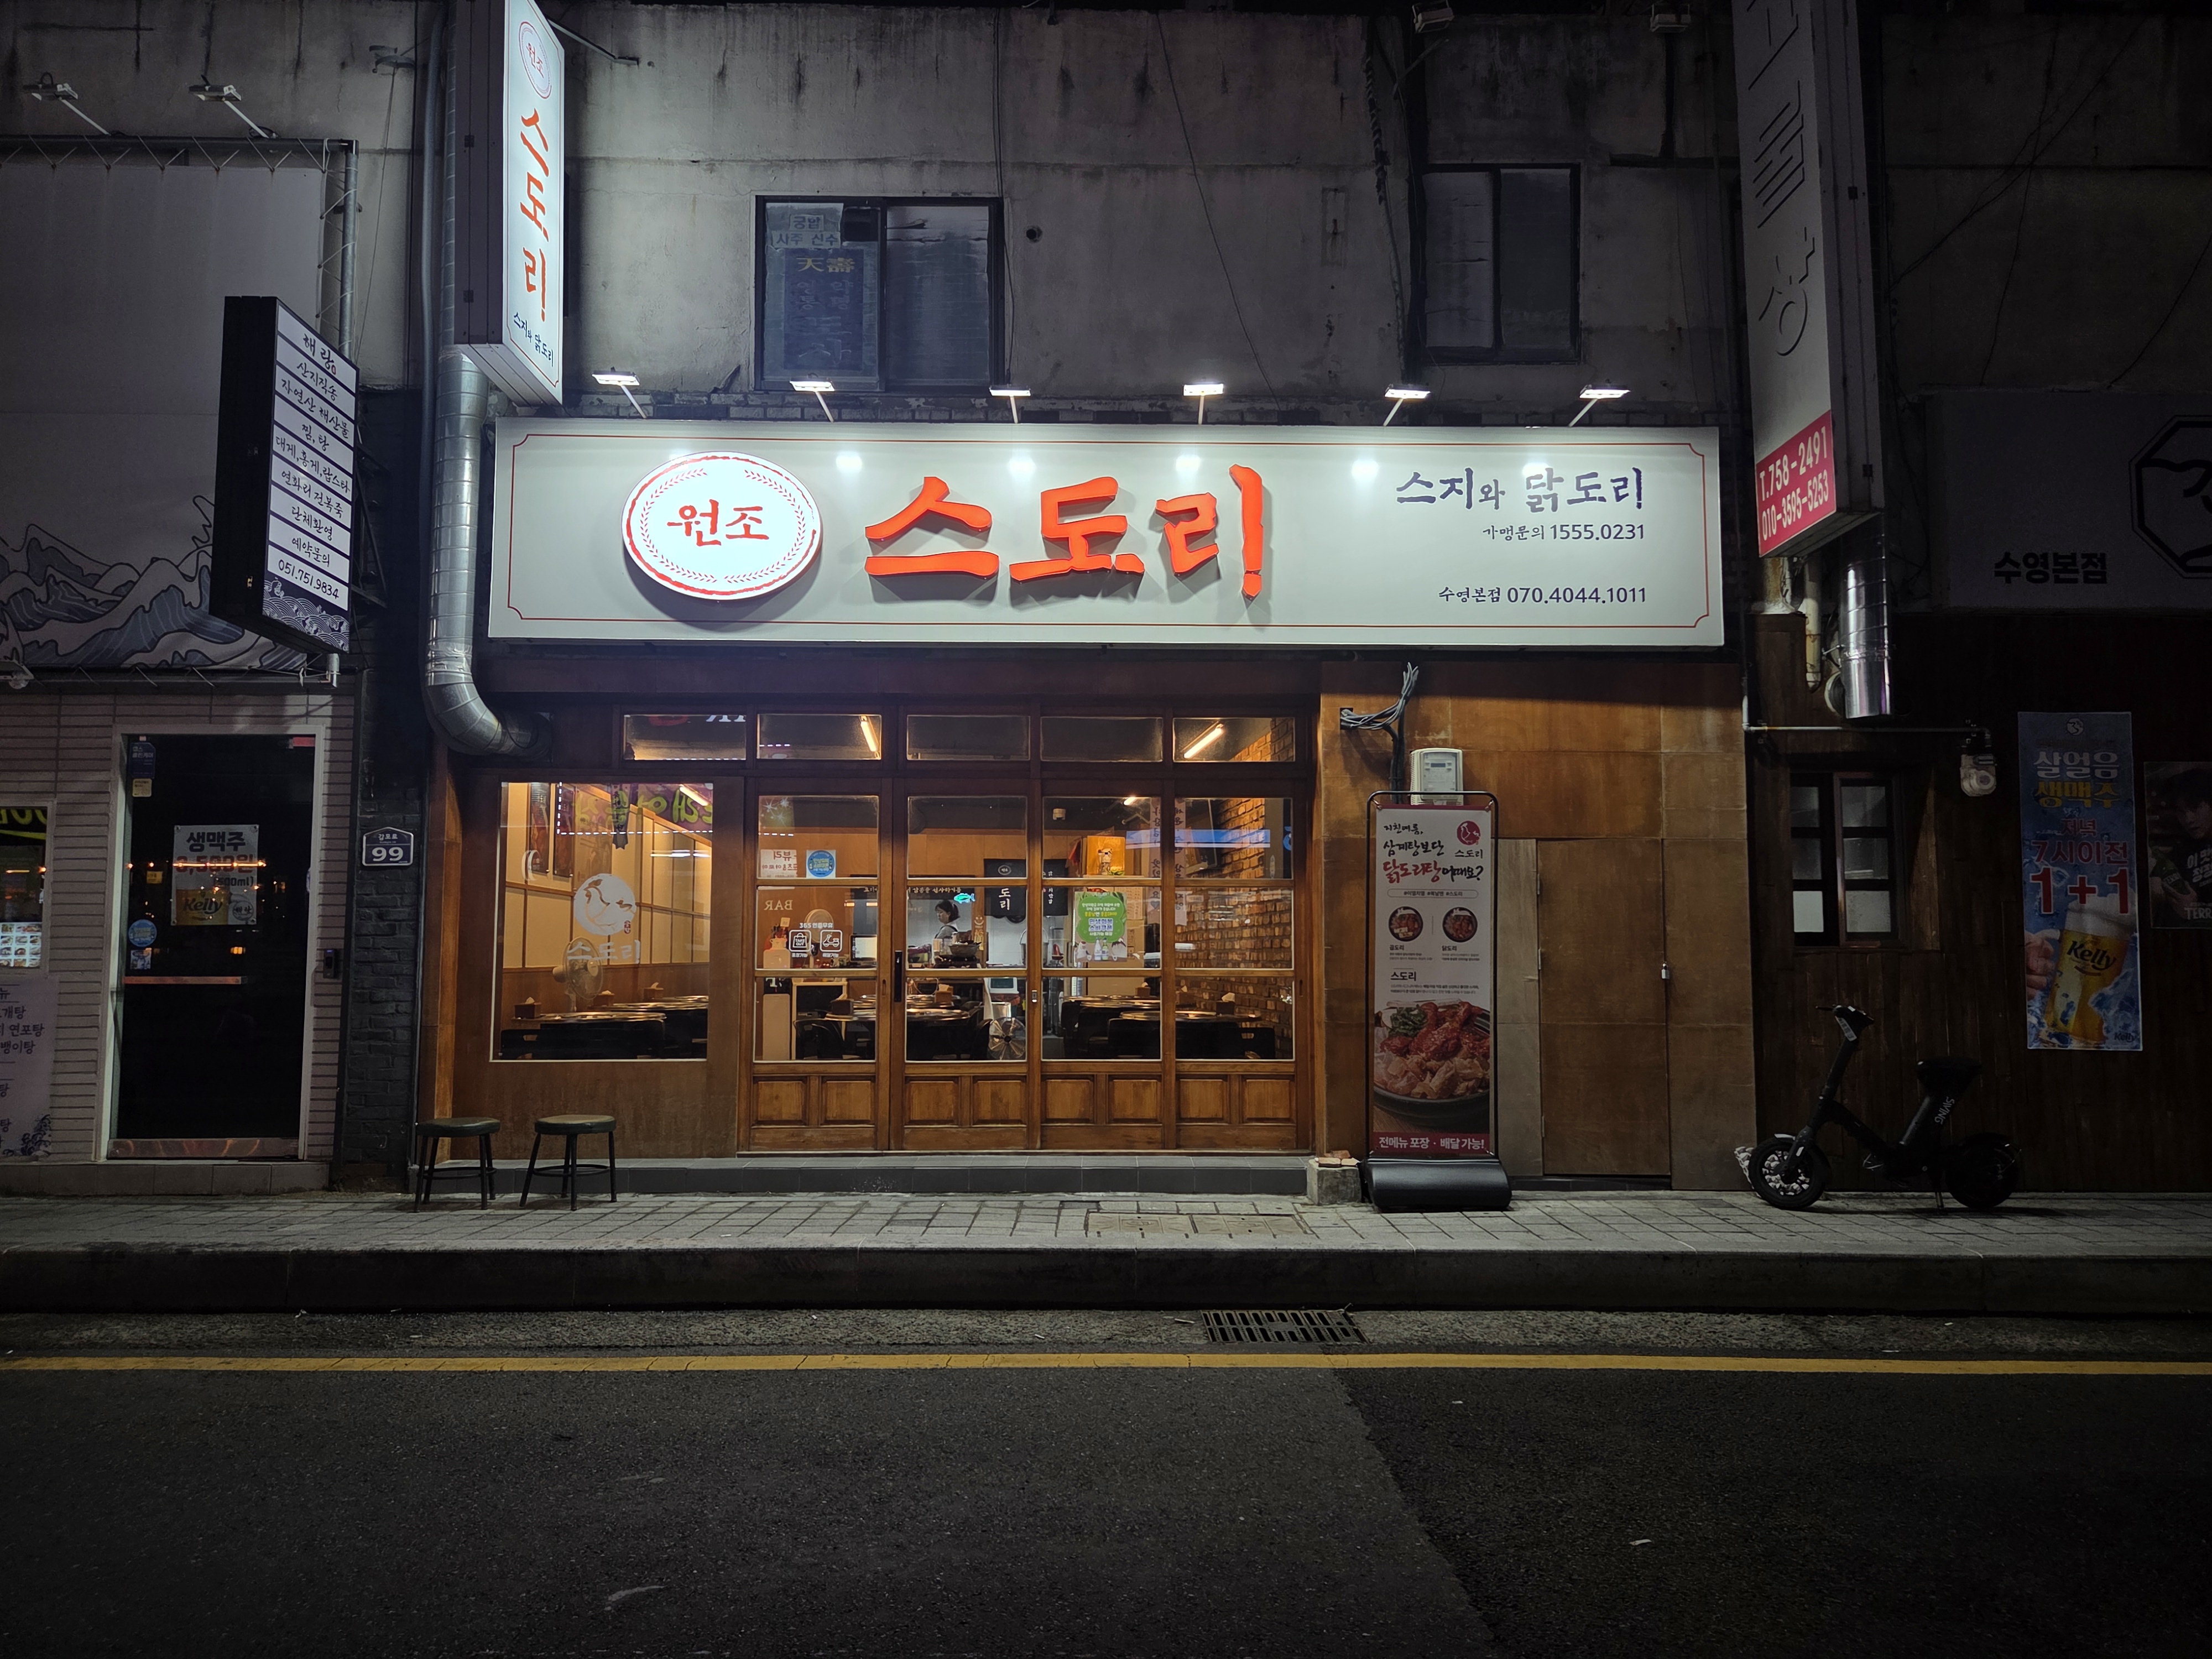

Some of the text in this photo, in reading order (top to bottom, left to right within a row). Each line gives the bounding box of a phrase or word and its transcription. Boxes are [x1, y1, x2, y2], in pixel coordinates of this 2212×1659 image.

[526, 43, 544, 79] 원조
[520, 107, 549, 322] 스도리
[793, 216, 821, 230] 궁합
[776, 232, 839, 246] 사주 신수
[513, 312, 554, 368] 스지와 닭도리
[297, 362, 338, 402] 산지직송
[281, 378, 349, 440] 자연산 해산물
[317, 433, 330, 452] 탕
[1760, 426, 1827, 501] T.758-2491
[281, 469, 343, 519] 연화리 전복죽
[1396, 467, 1642, 513] 스지와 닭도리
[1762, 469, 1829, 541] 010-3595-5253
[292, 506, 333, 542] 단체환영
[667, 499, 769, 546] 원조
[865, 464, 1262, 600] 스도리
[1483, 524, 1645, 541] 가맹문의 1555.0231
[292, 536, 331, 567] 예약문의
[278, 558, 340, 600] 051.751.9834
[1994, 552, 2108, 584] 수영본점
[1438, 586, 1646, 604] 수영본점 070.4044.1011
[2033, 751, 2120, 779] 살얼음
[2034, 780, 2121, 808] 생맥주
[2060, 818, 2097, 837] 저녁
[186, 831, 246, 852] 생맥주
[1383, 839, 1444, 857] 삼계탕보단
[1454, 849, 1483, 858] 스도리
[2031, 839, 2129, 865] 7시이전
[372, 847, 404, 862] 99
[1383, 859, 1442, 883] 닭도리탕
[183, 896, 223, 915] Kelly
[998, 888, 1011, 910] 도리
[2184, 907, 2212, 920] TERR
[567, 940, 640, 964] 스도리
[2066, 939, 2117, 971] Kelly
[1390, 972, 1417, 982] 스도리
[0, 1005, 27, 1019] 개탕
[9, 1023, 45, 1037] 연포탕
[1379, 1136, 1485, 1150] 전메뉴 포장 배달 가능!
